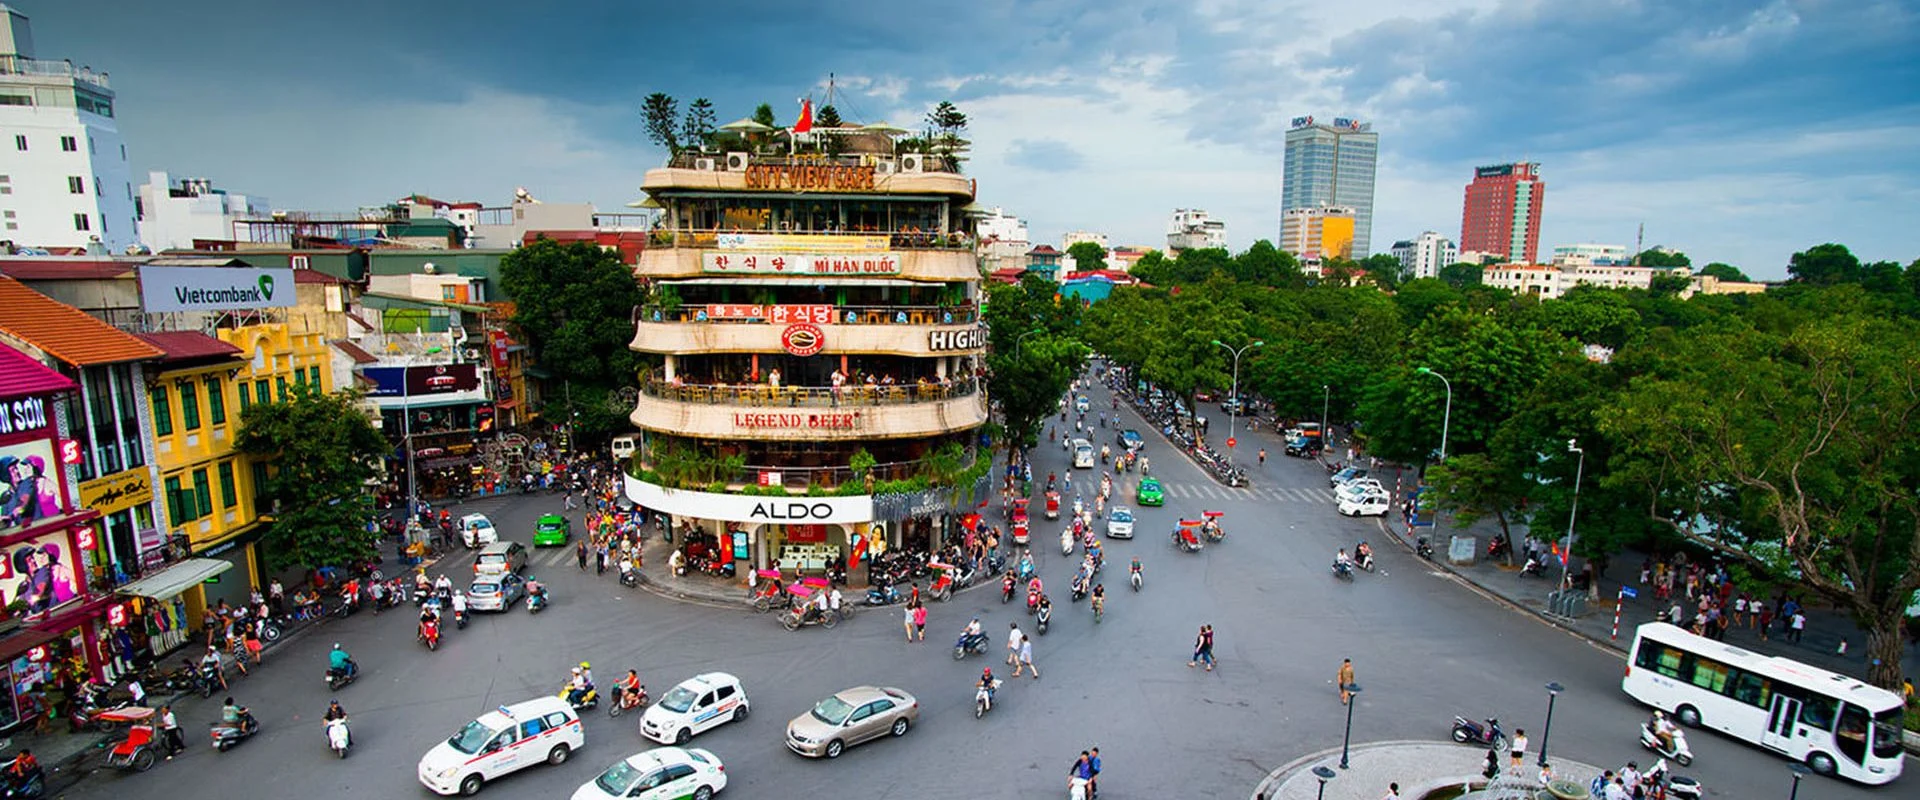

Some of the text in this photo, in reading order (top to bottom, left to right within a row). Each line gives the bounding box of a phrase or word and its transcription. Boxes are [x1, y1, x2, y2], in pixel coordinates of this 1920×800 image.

[745, 165, 875, 189] CITY VIEW CAFE
[863, 256, 895, 273] QUỐC
[175, 286, 261, 304] Vietcombank
[735, 413, 854, 428] LEGEND BEER
[750, 502, 833, 519] ALDO
